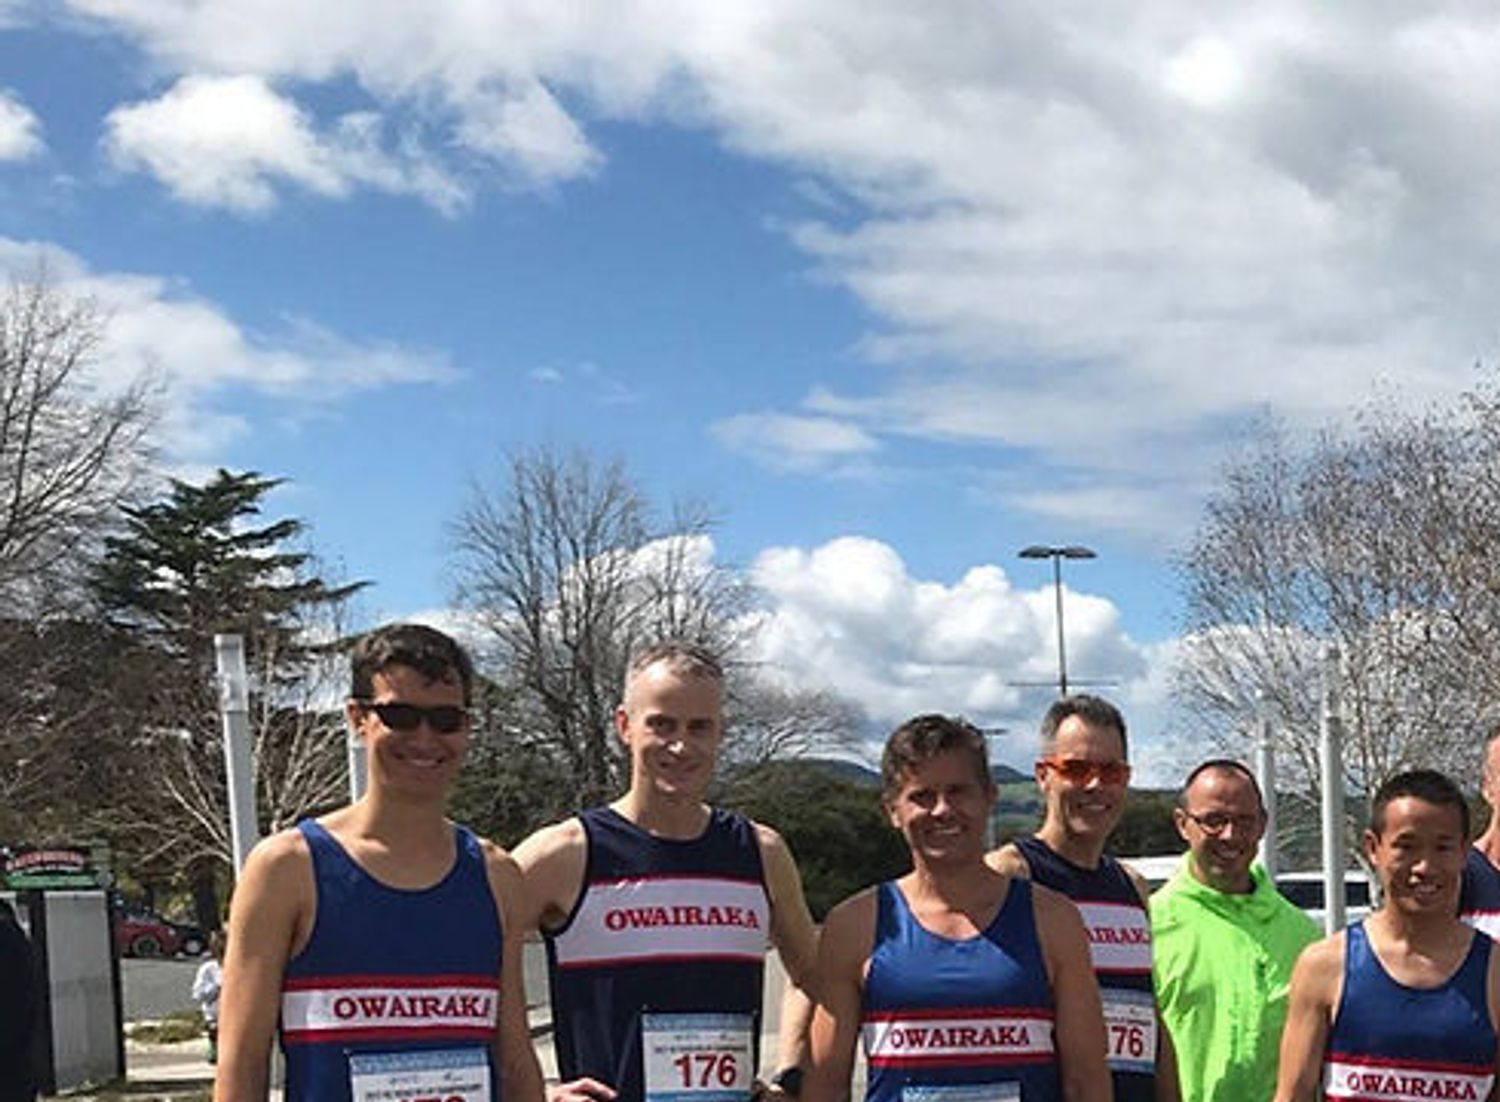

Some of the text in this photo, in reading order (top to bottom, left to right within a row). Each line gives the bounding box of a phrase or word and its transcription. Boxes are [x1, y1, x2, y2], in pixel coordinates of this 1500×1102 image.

[605, 906, 759, 931] OWAIRAKA
[1083, 928, 1151, 944] AIRAK
[890, 1026, 1030, 1048] OWAIRAKA
[1105, 1026, 1143, 1057] 76
[674, 1054, 737, 1087] 176
[1347, 1072, 1477, 1100] OWAIRAKA
